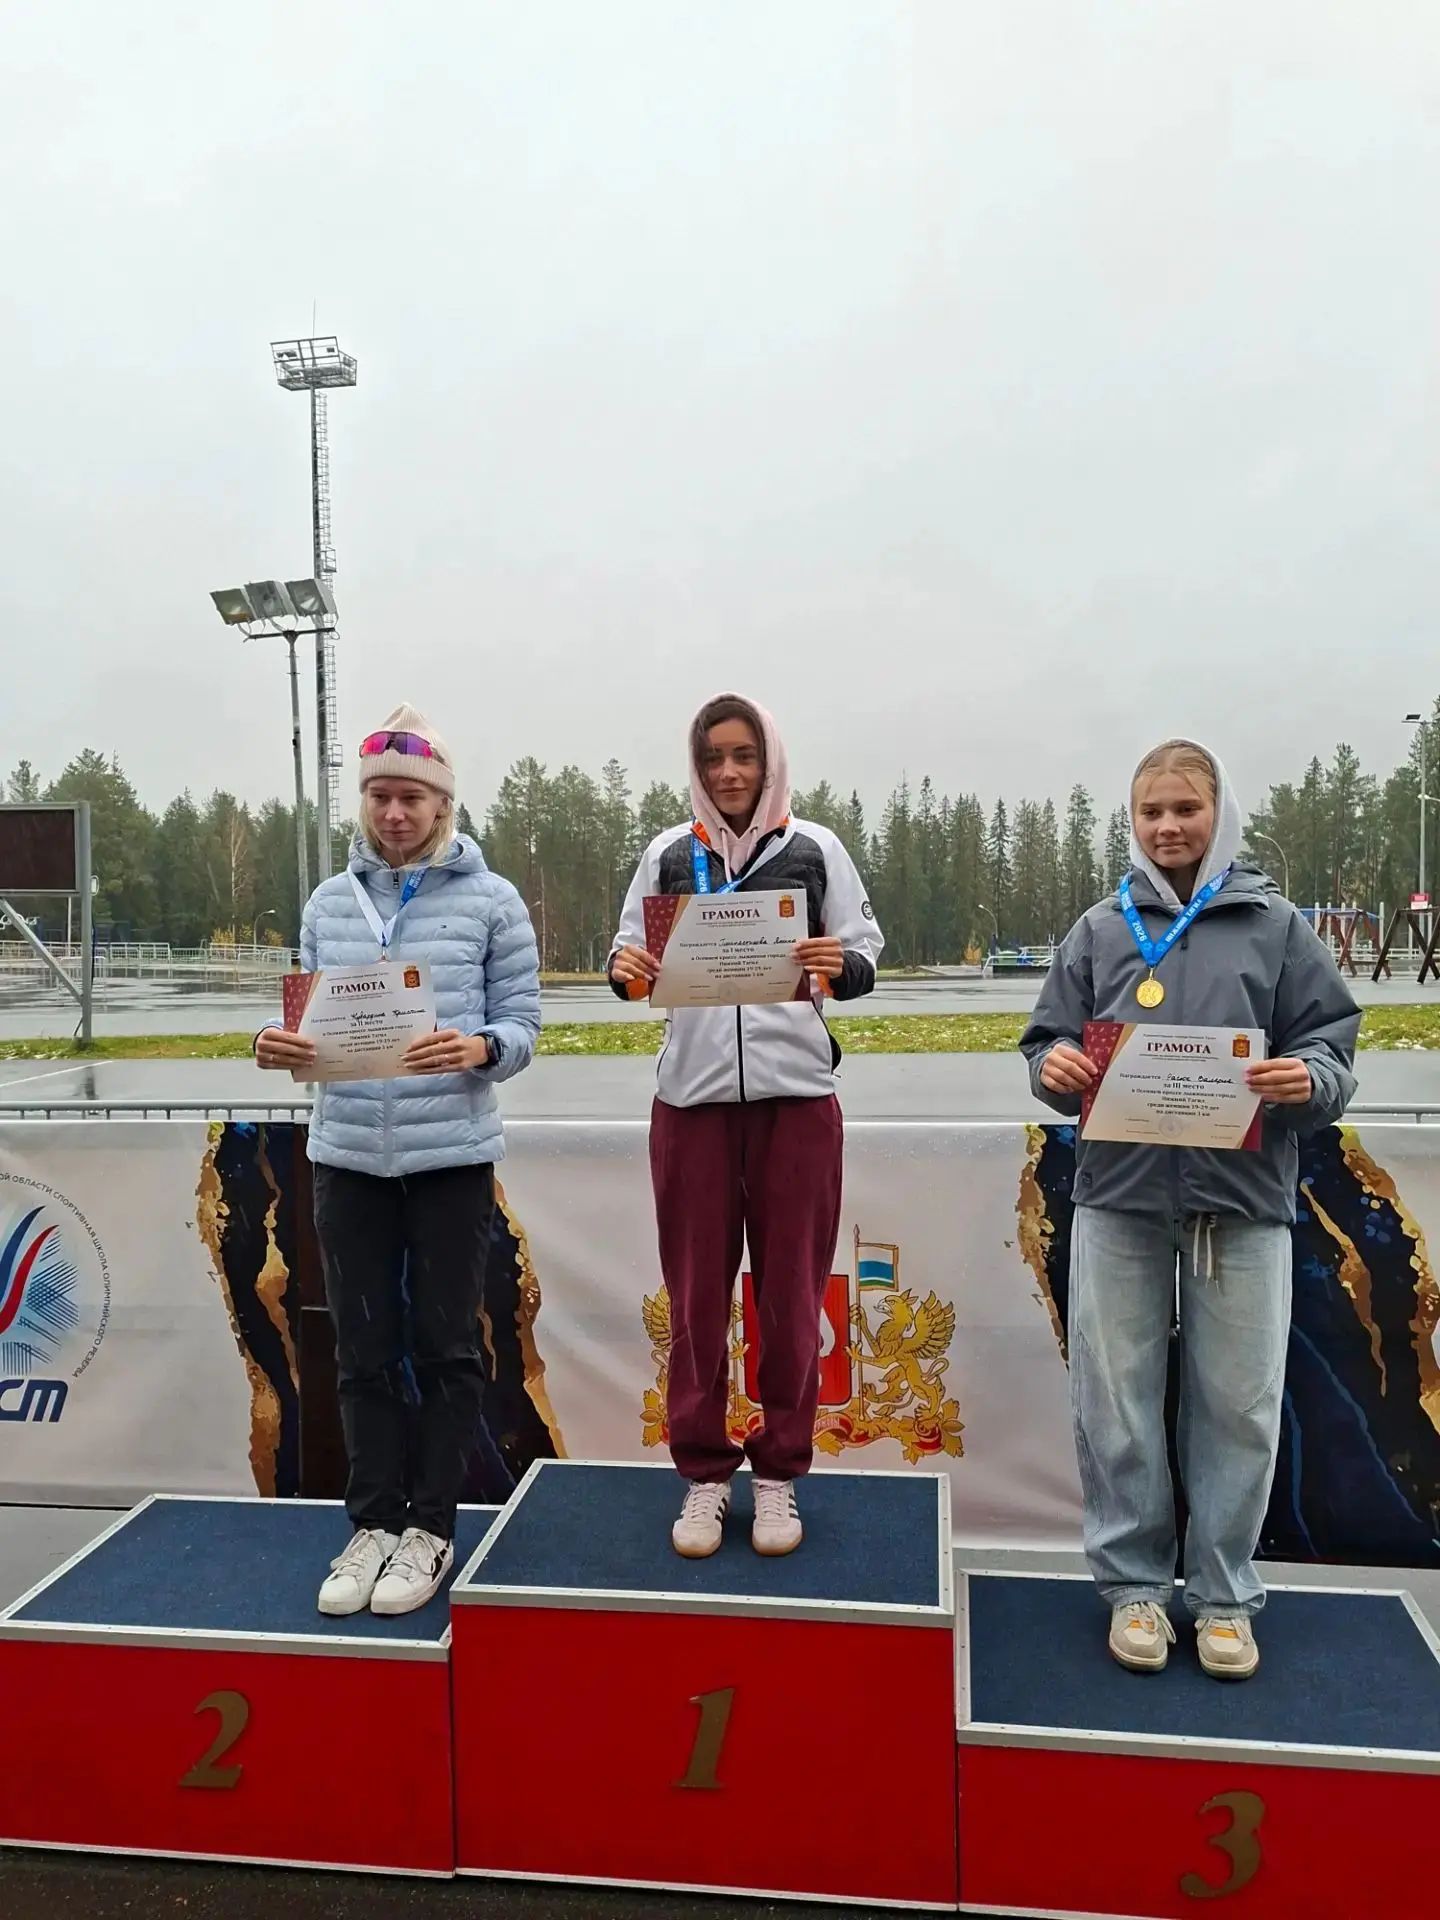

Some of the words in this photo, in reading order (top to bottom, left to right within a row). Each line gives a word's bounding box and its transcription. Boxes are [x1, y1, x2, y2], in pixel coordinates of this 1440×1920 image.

[698, 871, 708, 893] 2026
[702, 908, 760, 920] ГРАМОТА
[1132, 921, 1148, 942] 2026
[331, 980, 386, 994] ГРАМОТА
[1147, 1042, 1211, 1054] ГРАМОТА
[11, 1175, 53, 1194] ОБЛАСТИ
[53, 1191, 97, 1239] СПОРТИВНАЯ
[92, 1238, 108, 1271] ШКОЛА
[94, 1272, 112, 1345] ОЛИМПИЙСКОГО
[72, 1346, 98, 1378] РЕЗЕРВА
[179, 1690, 249, 1788] 2
[674, 1687, 734, 1788] 1
[1180, 1790, 1265, 1898] 3
